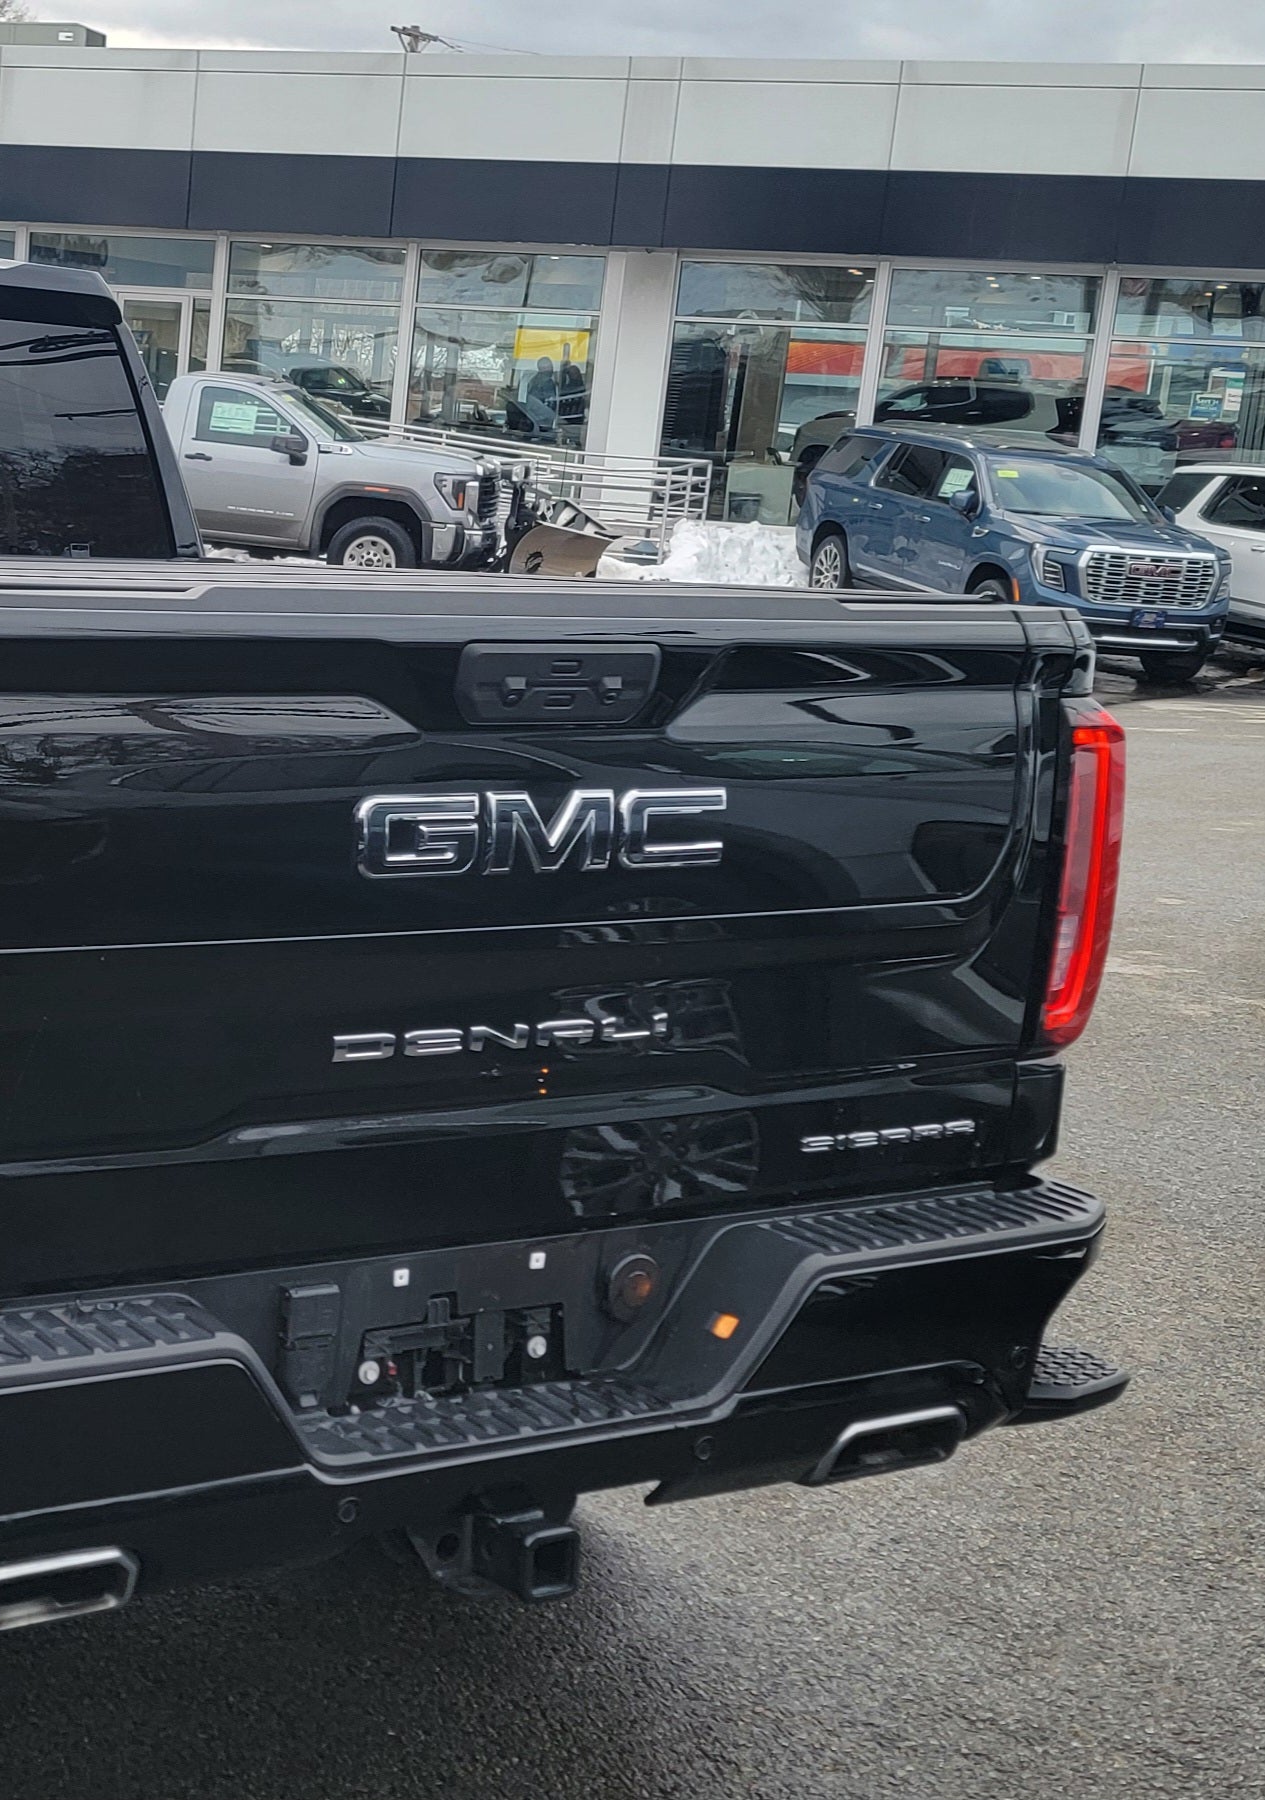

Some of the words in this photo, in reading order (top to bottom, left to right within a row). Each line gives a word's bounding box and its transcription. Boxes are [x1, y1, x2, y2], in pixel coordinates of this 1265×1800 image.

[356, 787, 727, 879] GMC
[332, 1012, 668, 1062] DENALI
[800, 1119, 976, 1152] SIERRA
